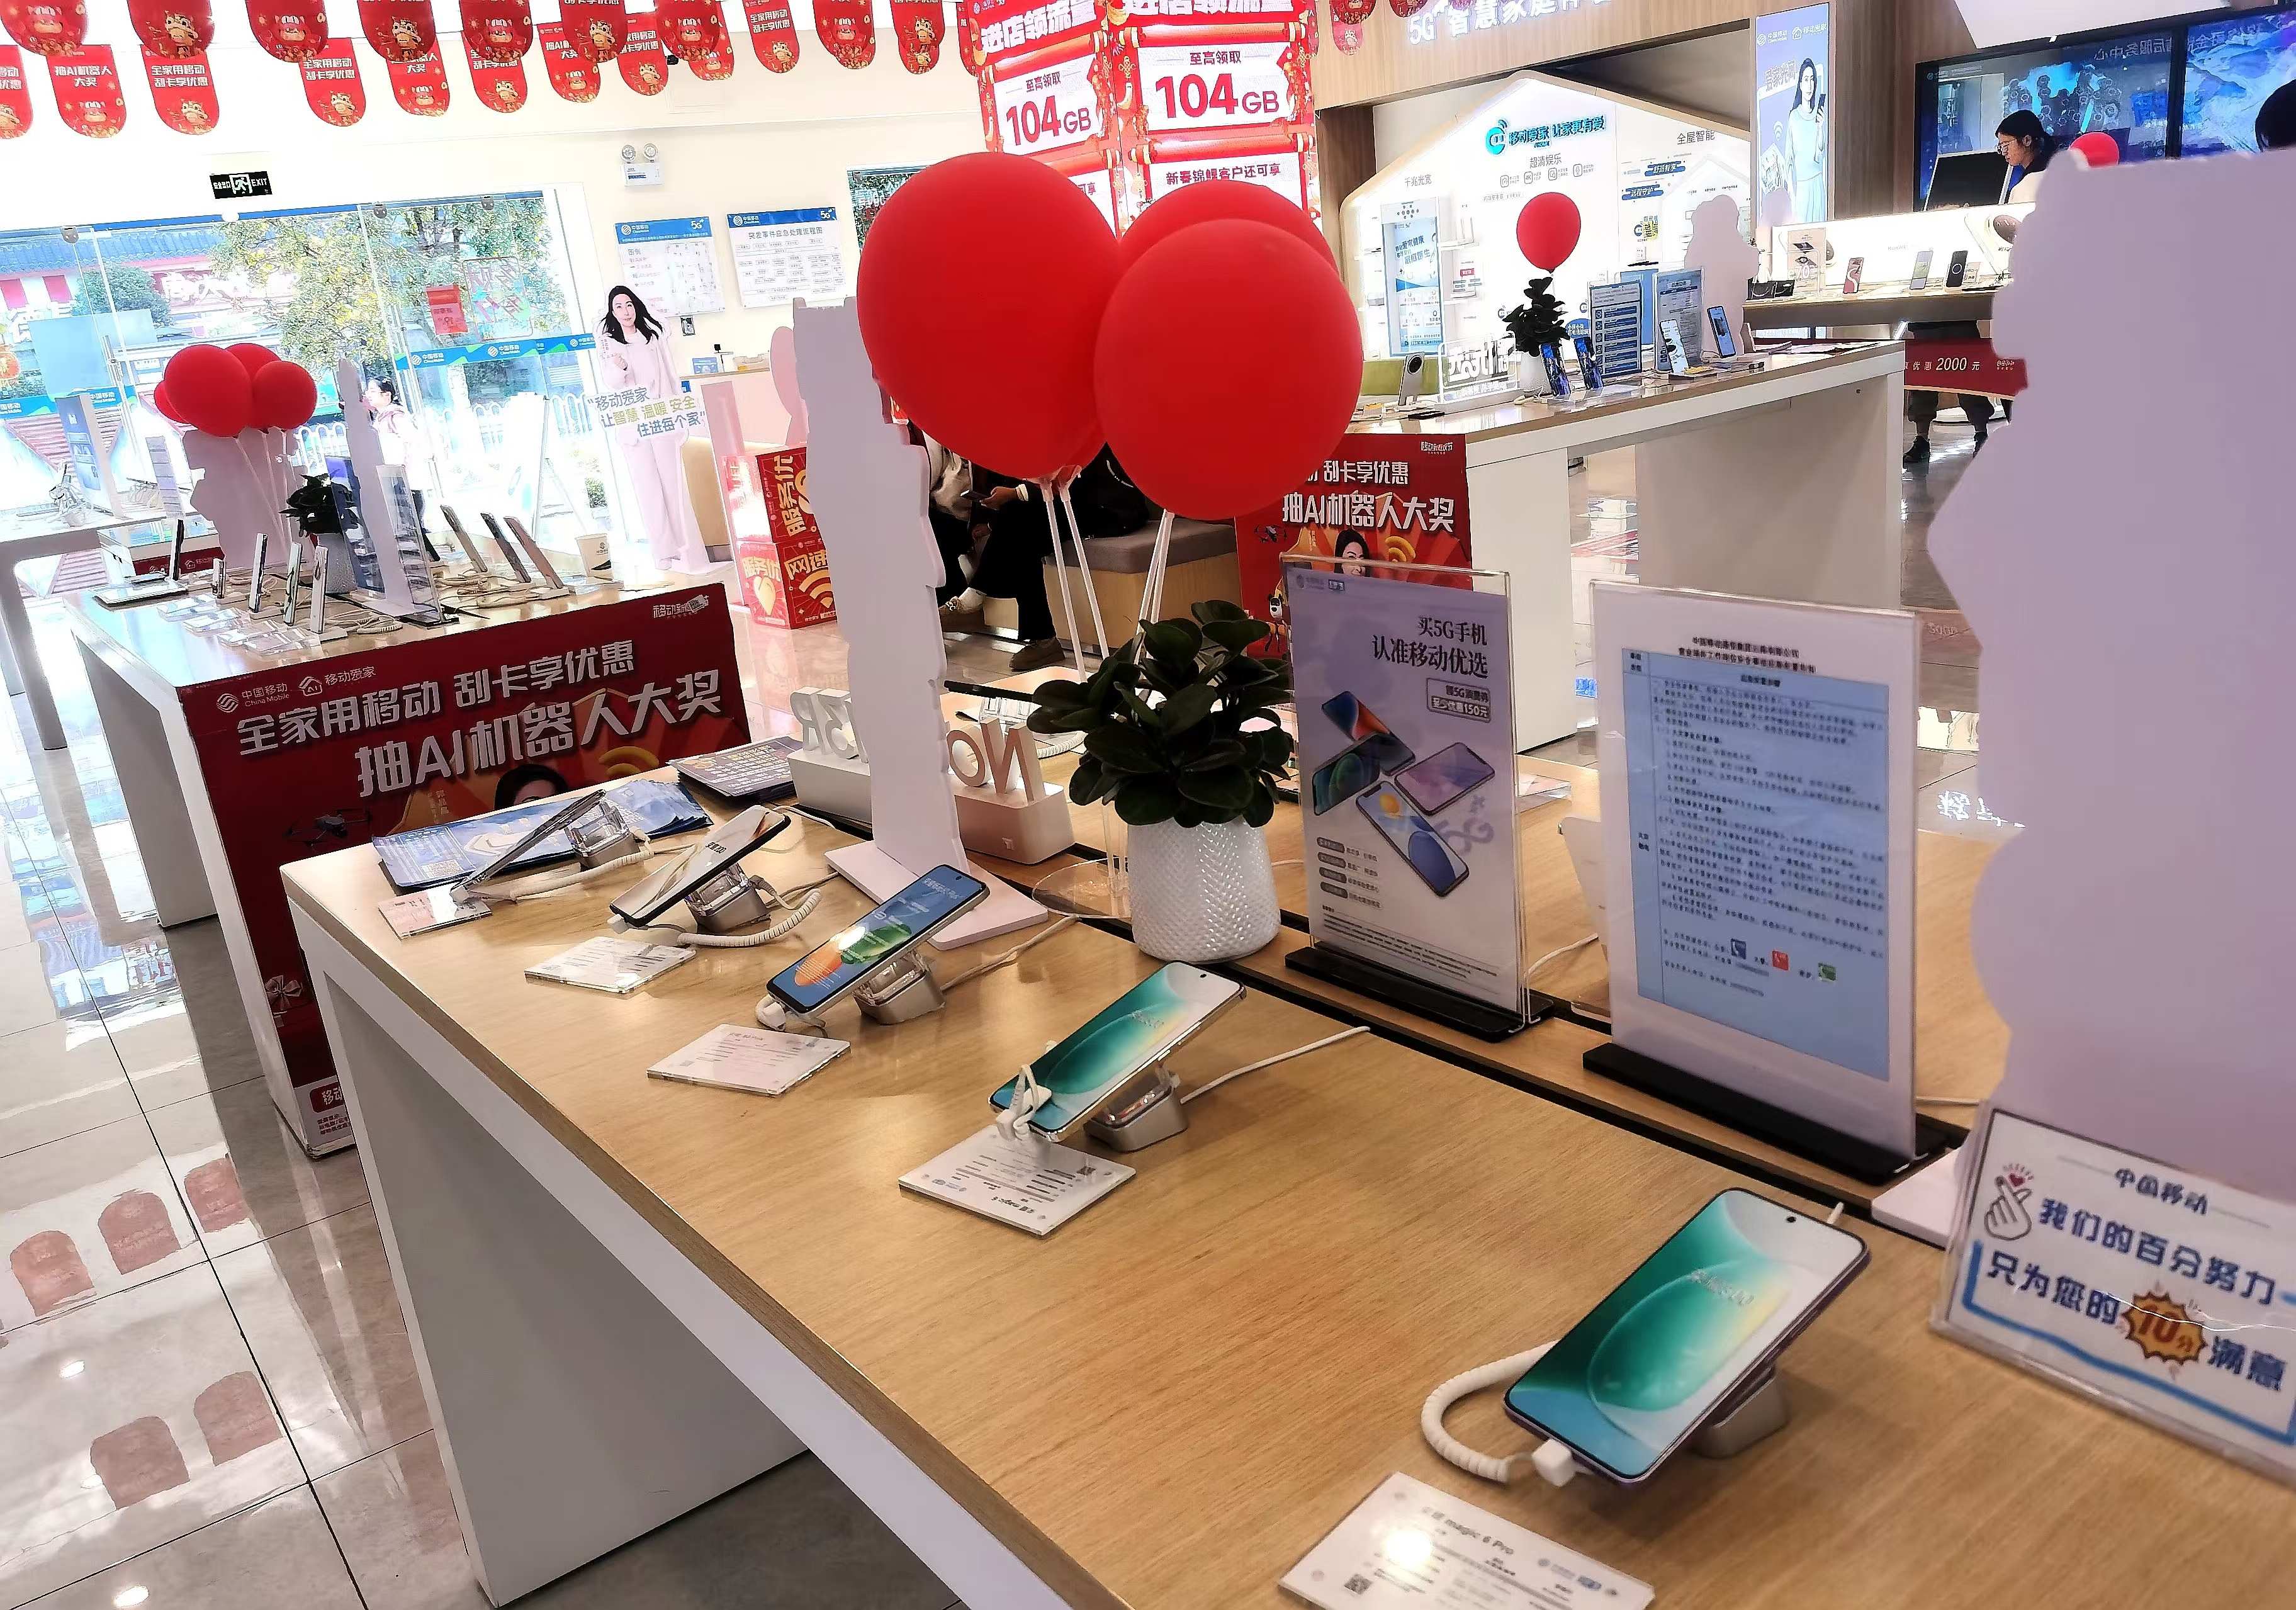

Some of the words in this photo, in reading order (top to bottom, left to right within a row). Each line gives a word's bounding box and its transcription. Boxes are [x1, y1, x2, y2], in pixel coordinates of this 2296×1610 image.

[1190, 50, 1242, 66] 至高领取
[151, 64, 206, 76] 全家用移动
[74, 77, 98, 87] 大奖
[1025, 71, 1061, 93] 至高领取
[1677, 129, 1716, 145] 全屋智能
[1529, 153, 1562, 168] 超清娱乐
[250, 178, 267, 187] EXIT
[690, 220, 702, 230] 5G
[820, 211, 831, 219] 5G
[1935, 357, 1967, 371] 2000
[1971, 361, 1980, 371] 元
[641, 401, 669, 420] 温暖
[669, 395, 697, 413] 安全
[1323, 459, 1409, 485] 刮卡享优惠
[1282, 490, 1455, 533] 抽AI机器人大奖
[1419, 616, 1488, 646] 买5G手机
[1371, 634, 1488, 679] 认准移动优选
[242, 682, 288, 701] 中国移动
[324, 666, 376, 686] 移动爱家
[453, 639, 634, 707] 刮卡享优惠
[244, 697, 266, 707] China
[267, 692, 290, 705] Mobile
[237, 680, 441, 755] 全家用移动
[355, 669, 723, 797] 抽AI机器人大奖
[2115, 1167, 2209, 1216] 中国移动
[2040, 1197, 2276, 1306] 我们的百分努力
[1987, 1250, 2121, 1325] 只为您的
[2208, 1334, 2288, 1392] 满意
[1492, 1536, 1516, 1557] Pro
